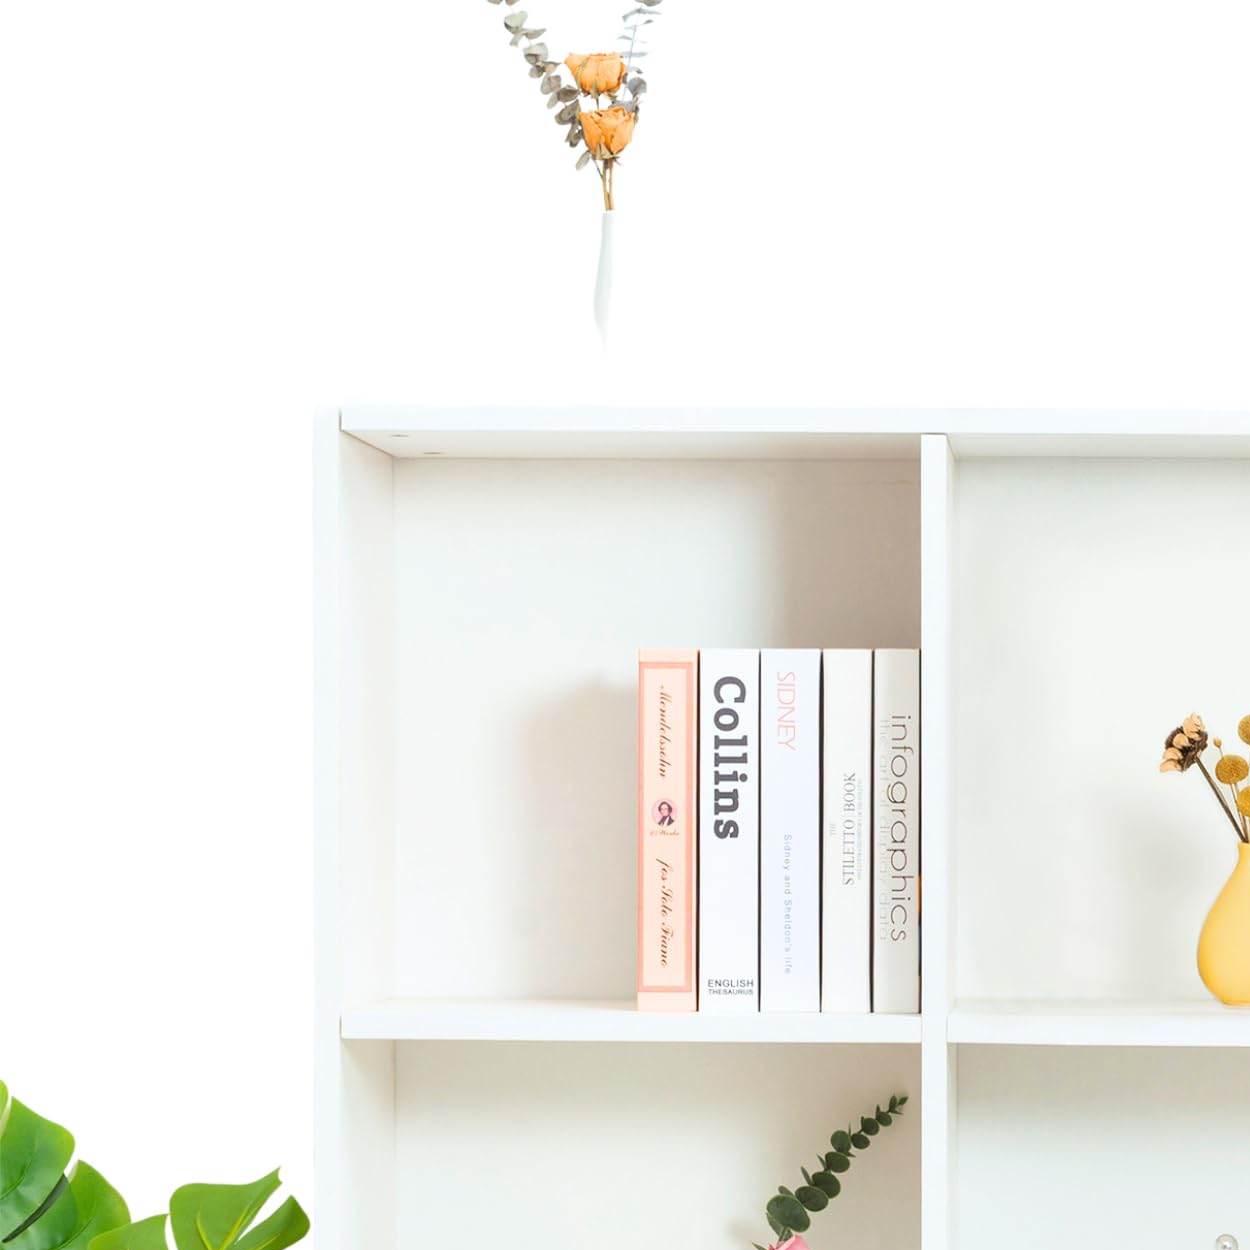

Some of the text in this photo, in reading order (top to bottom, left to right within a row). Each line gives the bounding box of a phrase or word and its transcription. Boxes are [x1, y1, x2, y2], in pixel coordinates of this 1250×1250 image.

[776, 671, 797, 751] SIDNEY
[713, 676, 748, 840] Collins
[782, 834, 792, 871] Sidney
[842, 772, 857, 887] STILETTO BOOK
[886, 714, 915, 942] infographics
[783, 875, 792, 895] and
[783, 899, 793, 953] Sheldon's
[707, 979, 754, 988] ENGLISH
